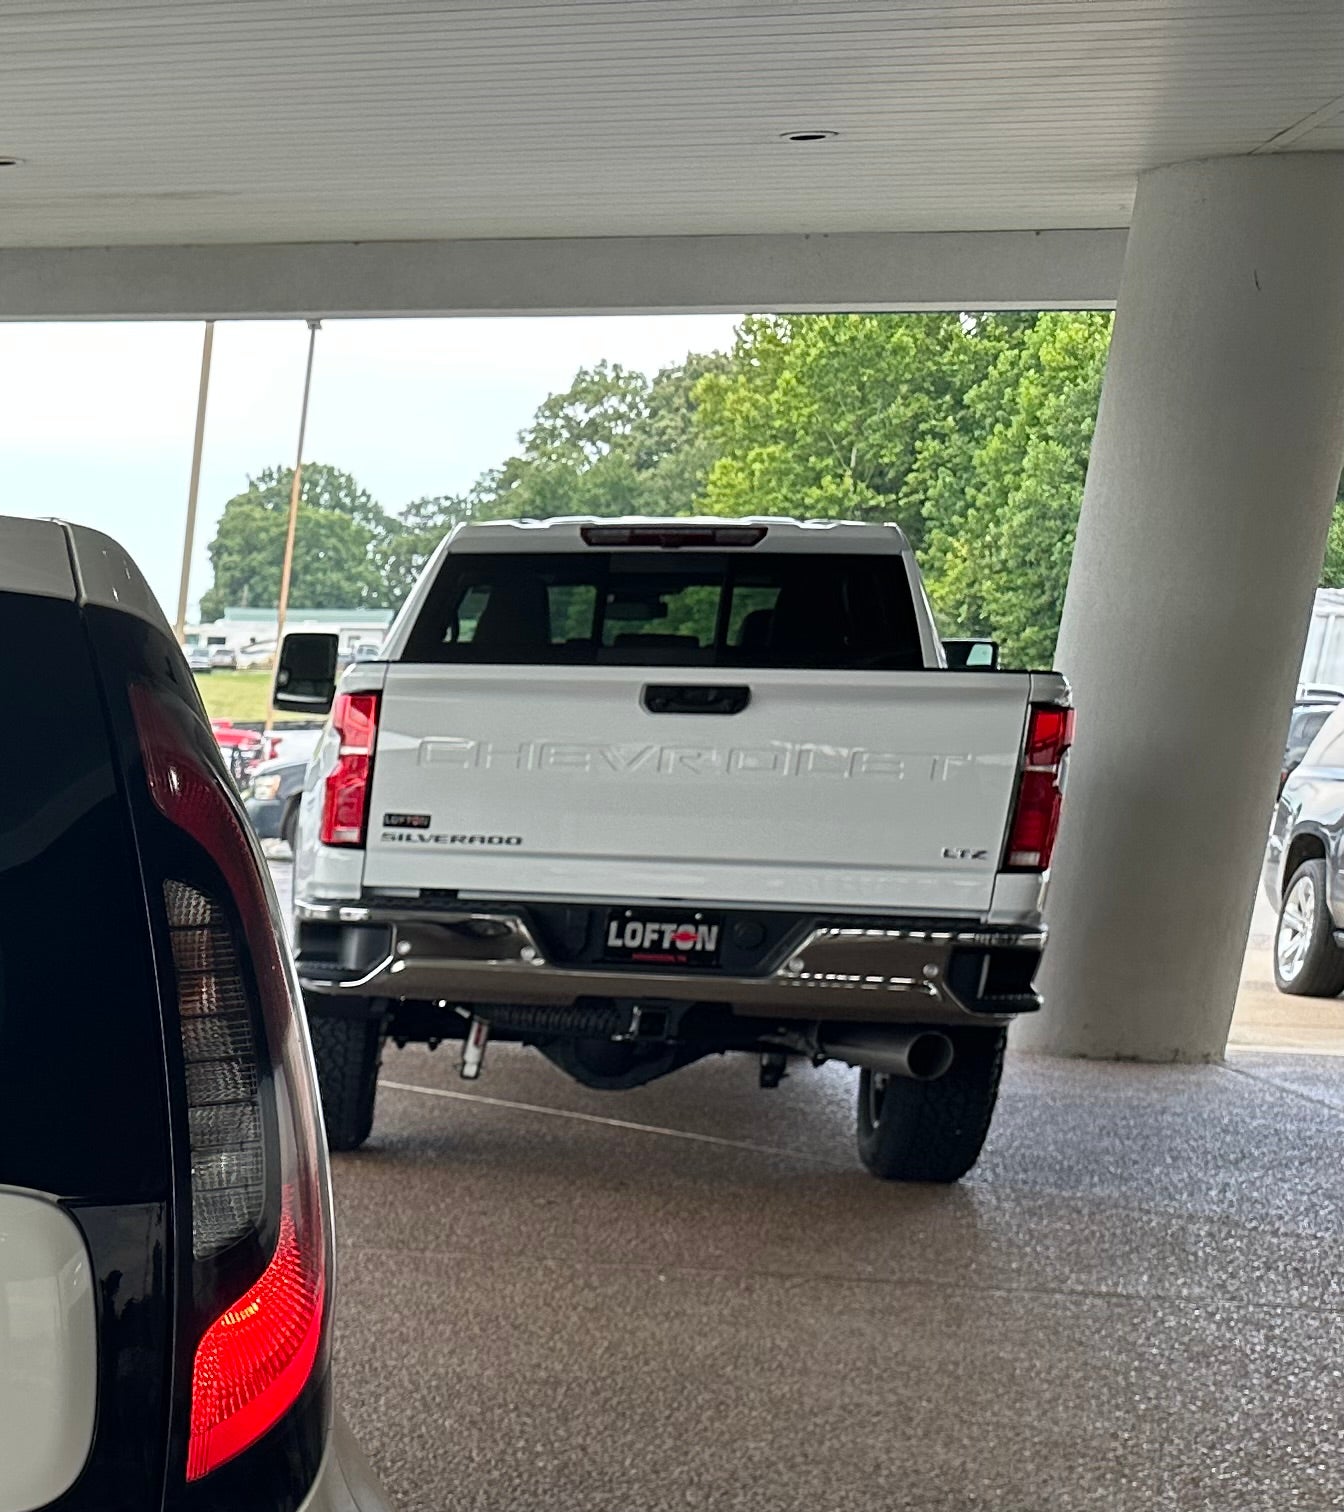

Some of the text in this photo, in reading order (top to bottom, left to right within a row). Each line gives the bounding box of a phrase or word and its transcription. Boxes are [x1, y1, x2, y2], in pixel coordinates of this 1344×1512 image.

[416, 736, 974, 782] CHEVROLET
[381, 832, 523, 846] SILVERADO
[941, 848, 989, 861] LTZ
[607, 920, 719, 952] LOFTON
